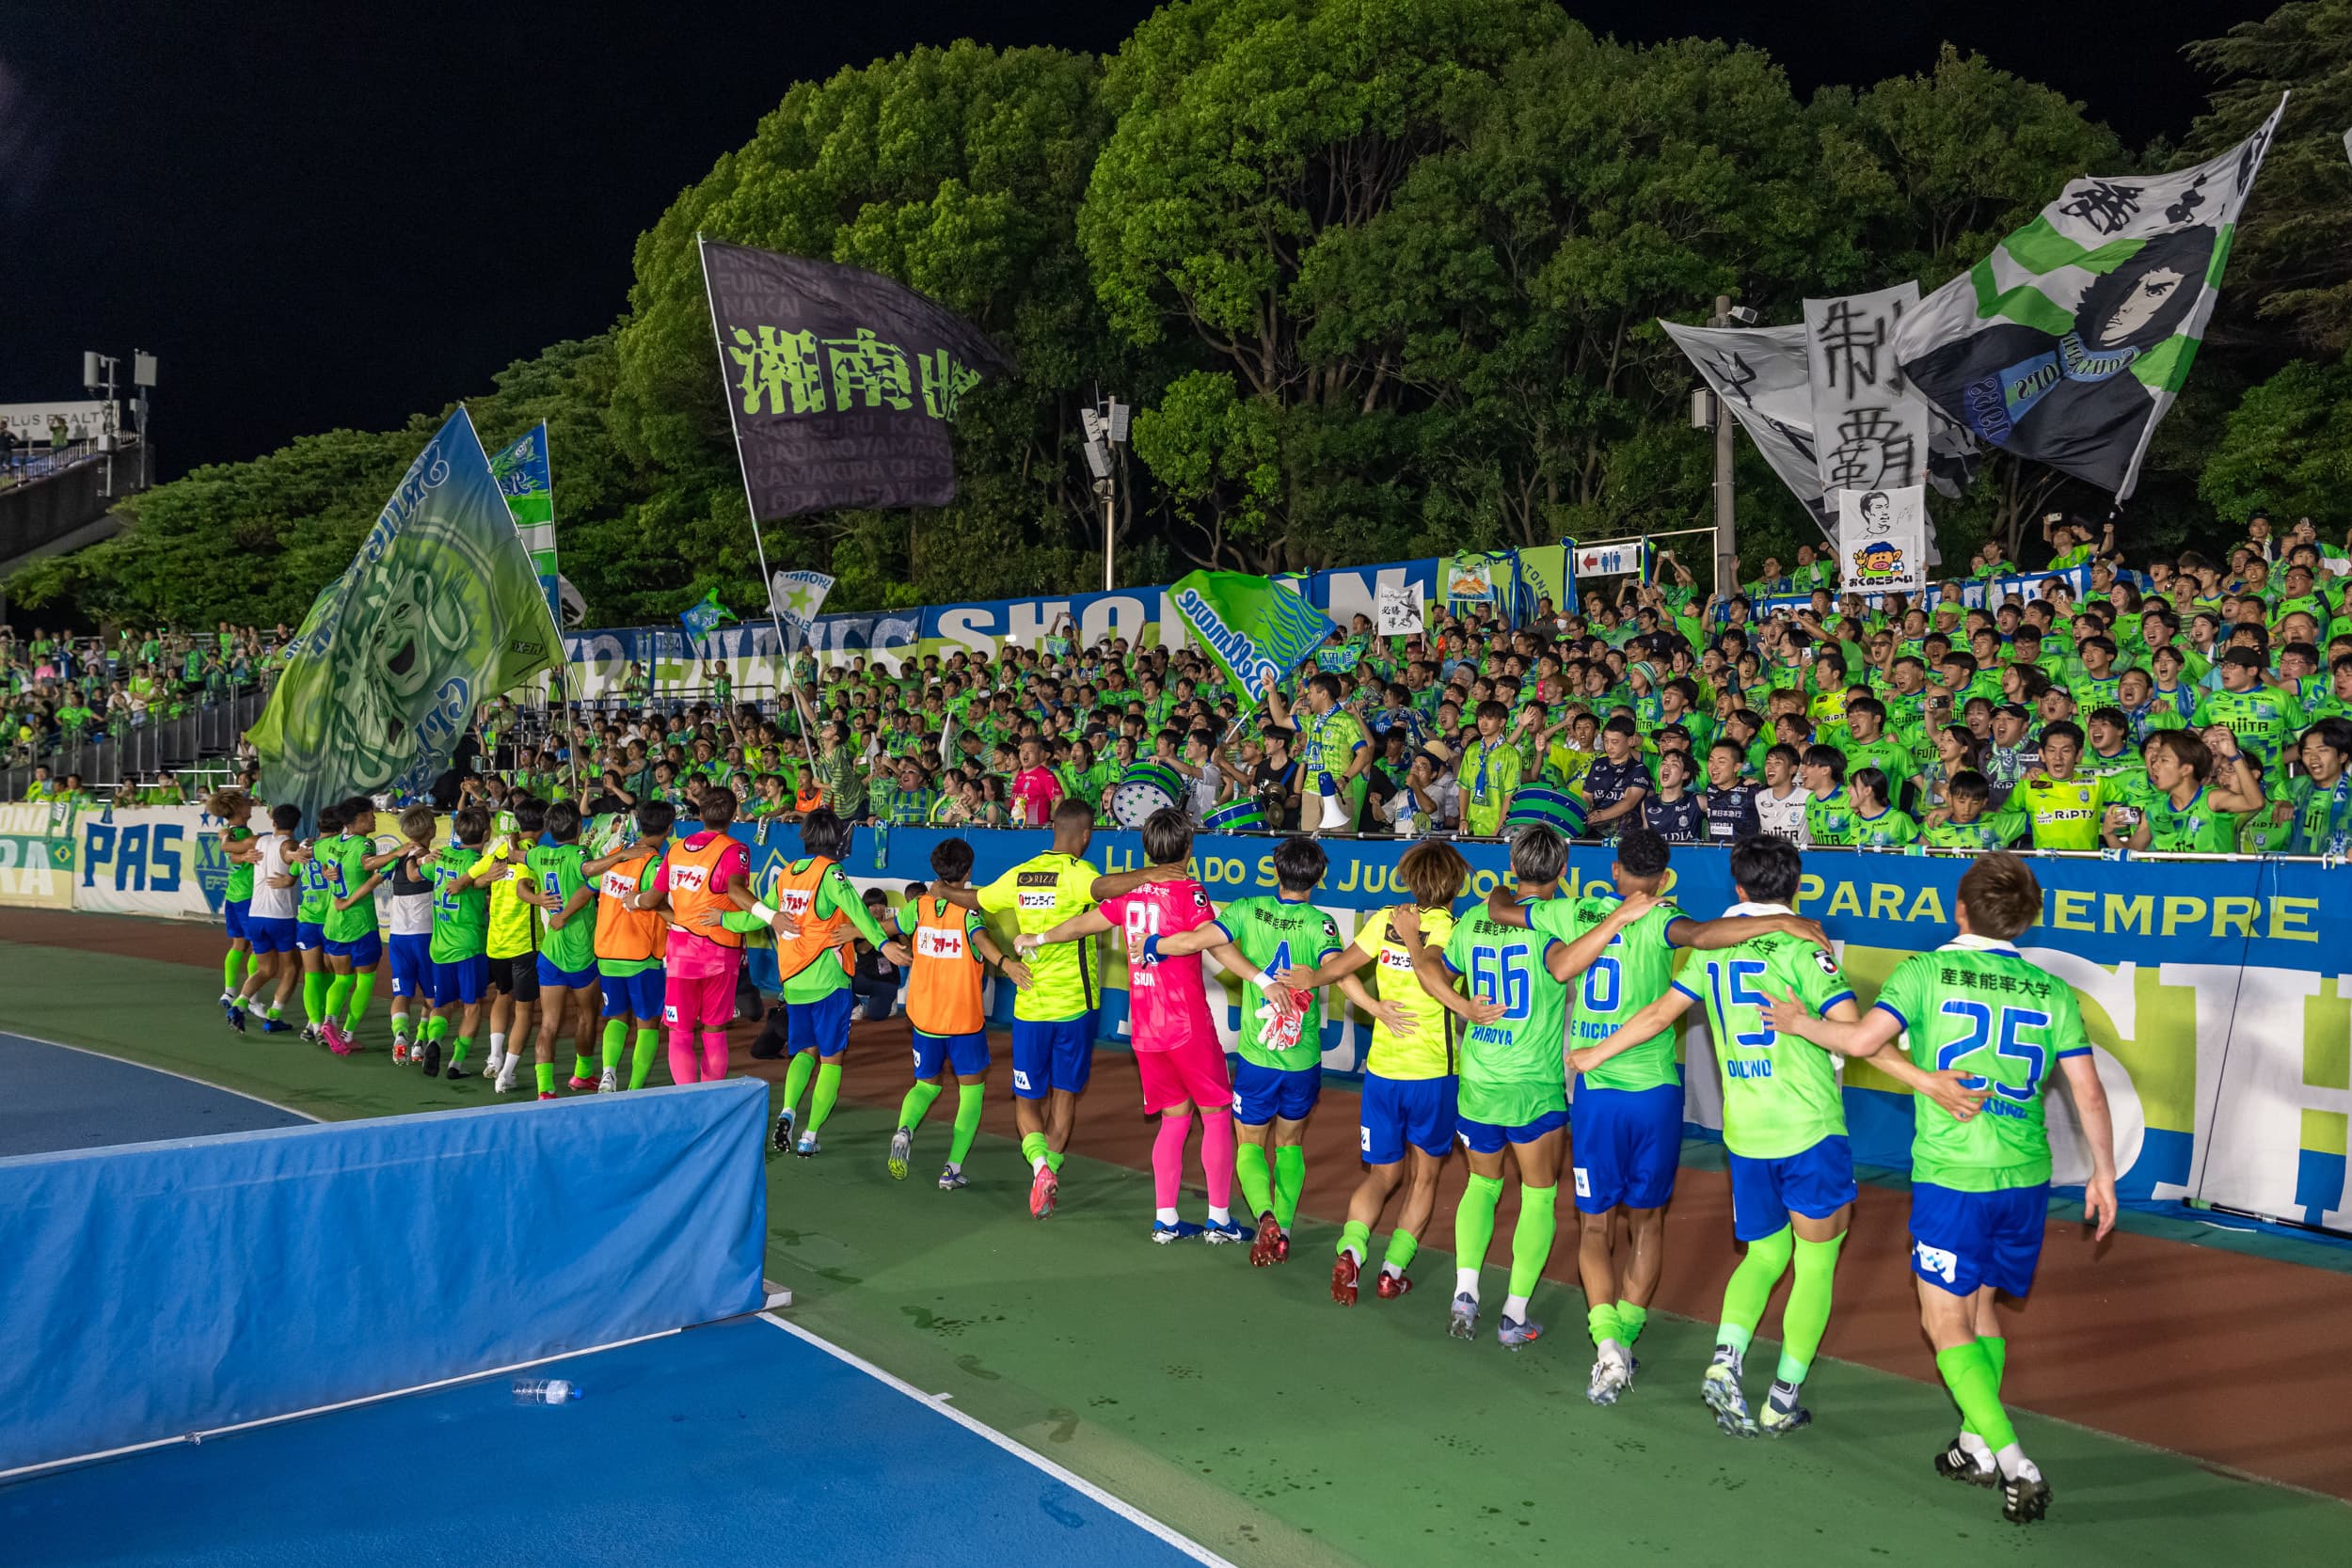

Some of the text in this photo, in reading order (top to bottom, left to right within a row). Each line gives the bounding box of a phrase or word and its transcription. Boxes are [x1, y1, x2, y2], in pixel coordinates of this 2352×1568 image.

[1849, 575, 1914, 588] おくのこうへい
[1104, 845, 1246, 885] LLADO
[1791, 873, 1947, 925] PARA
[2032, 888, 2319, 943] IEMPRE
[1470, 943, 1532, 1021] 66
[1706, 958, 1779, 1049] 15
[1941, 967, 2053, 1000] 産業能率大学
[1470, 1025, 1514, 1046] HIROYA
[1936, 997, 2053, 1102] 25
